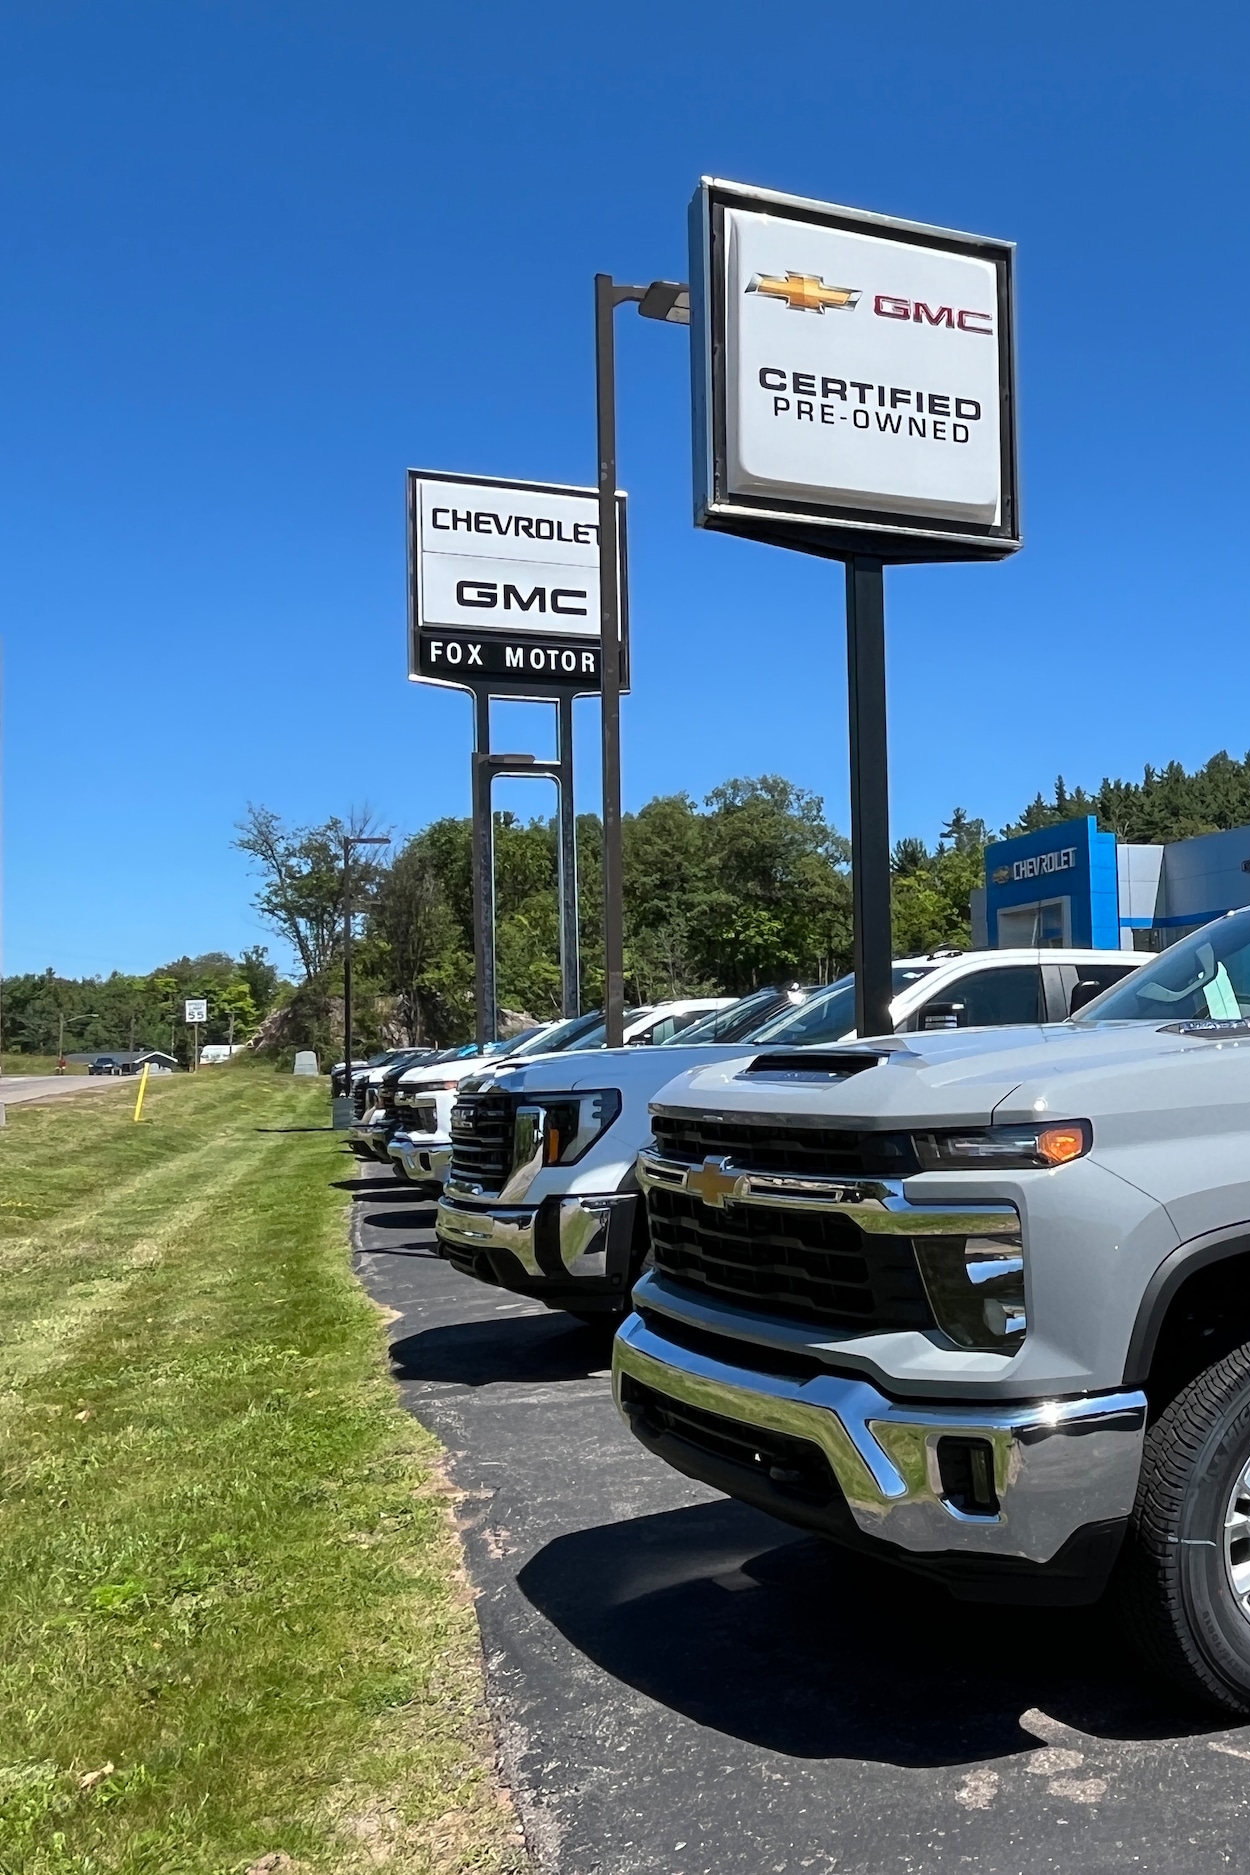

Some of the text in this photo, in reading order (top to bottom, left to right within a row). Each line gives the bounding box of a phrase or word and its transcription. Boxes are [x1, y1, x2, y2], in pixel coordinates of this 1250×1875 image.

[874, 294, 993, 336] GMC
[758, 366, 981, 421] CERTIFIED
[773, 396, 970, 444] PRE-OWNED
[456, 580, 587, 616] GMC
[430, 641, 596, 673] FOX MOTOR
[1013, 847, 1077, 881] CHEVROLET
[188, 1010, 205, 1020] 55
